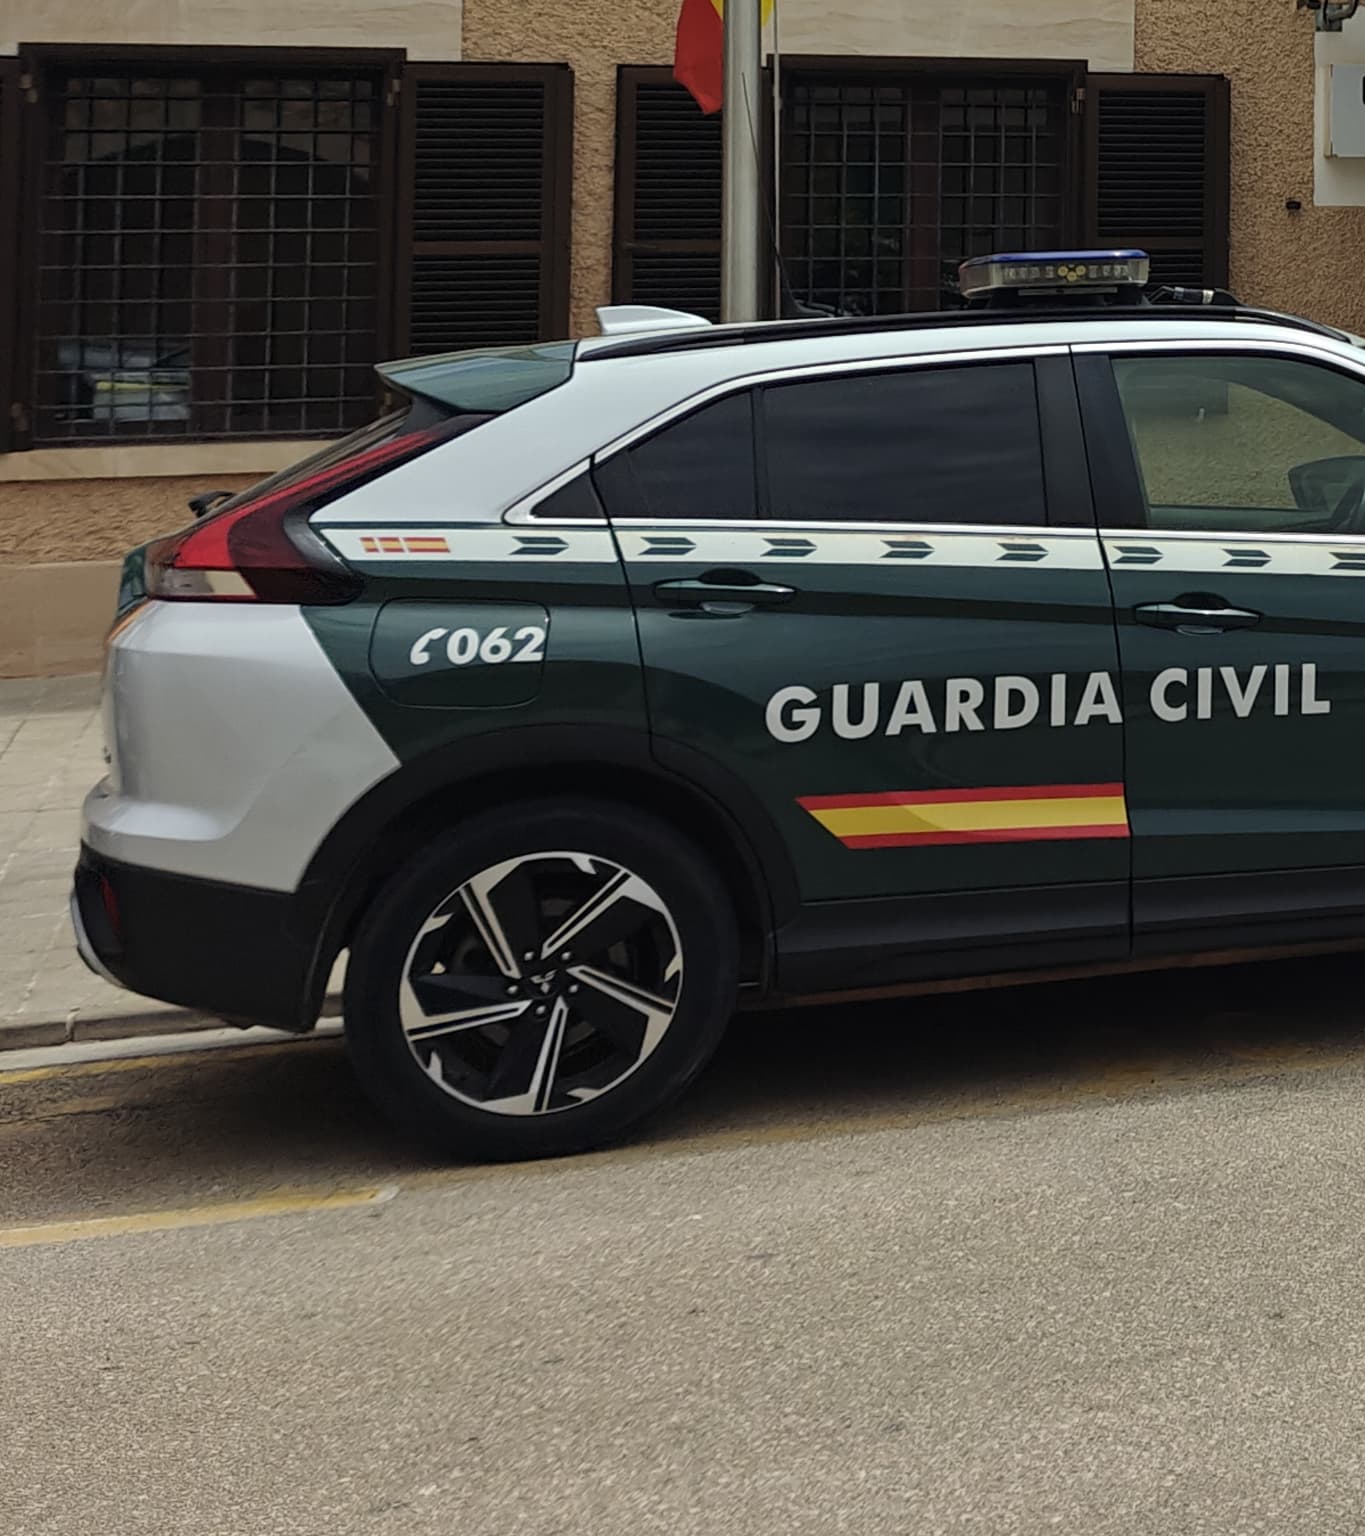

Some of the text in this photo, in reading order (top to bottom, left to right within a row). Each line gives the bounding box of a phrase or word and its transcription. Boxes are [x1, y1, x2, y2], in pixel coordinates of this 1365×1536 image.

[447, 626, 546, 665] 062
[765, 663, 1331, 743] GUARDIA CIVIL
